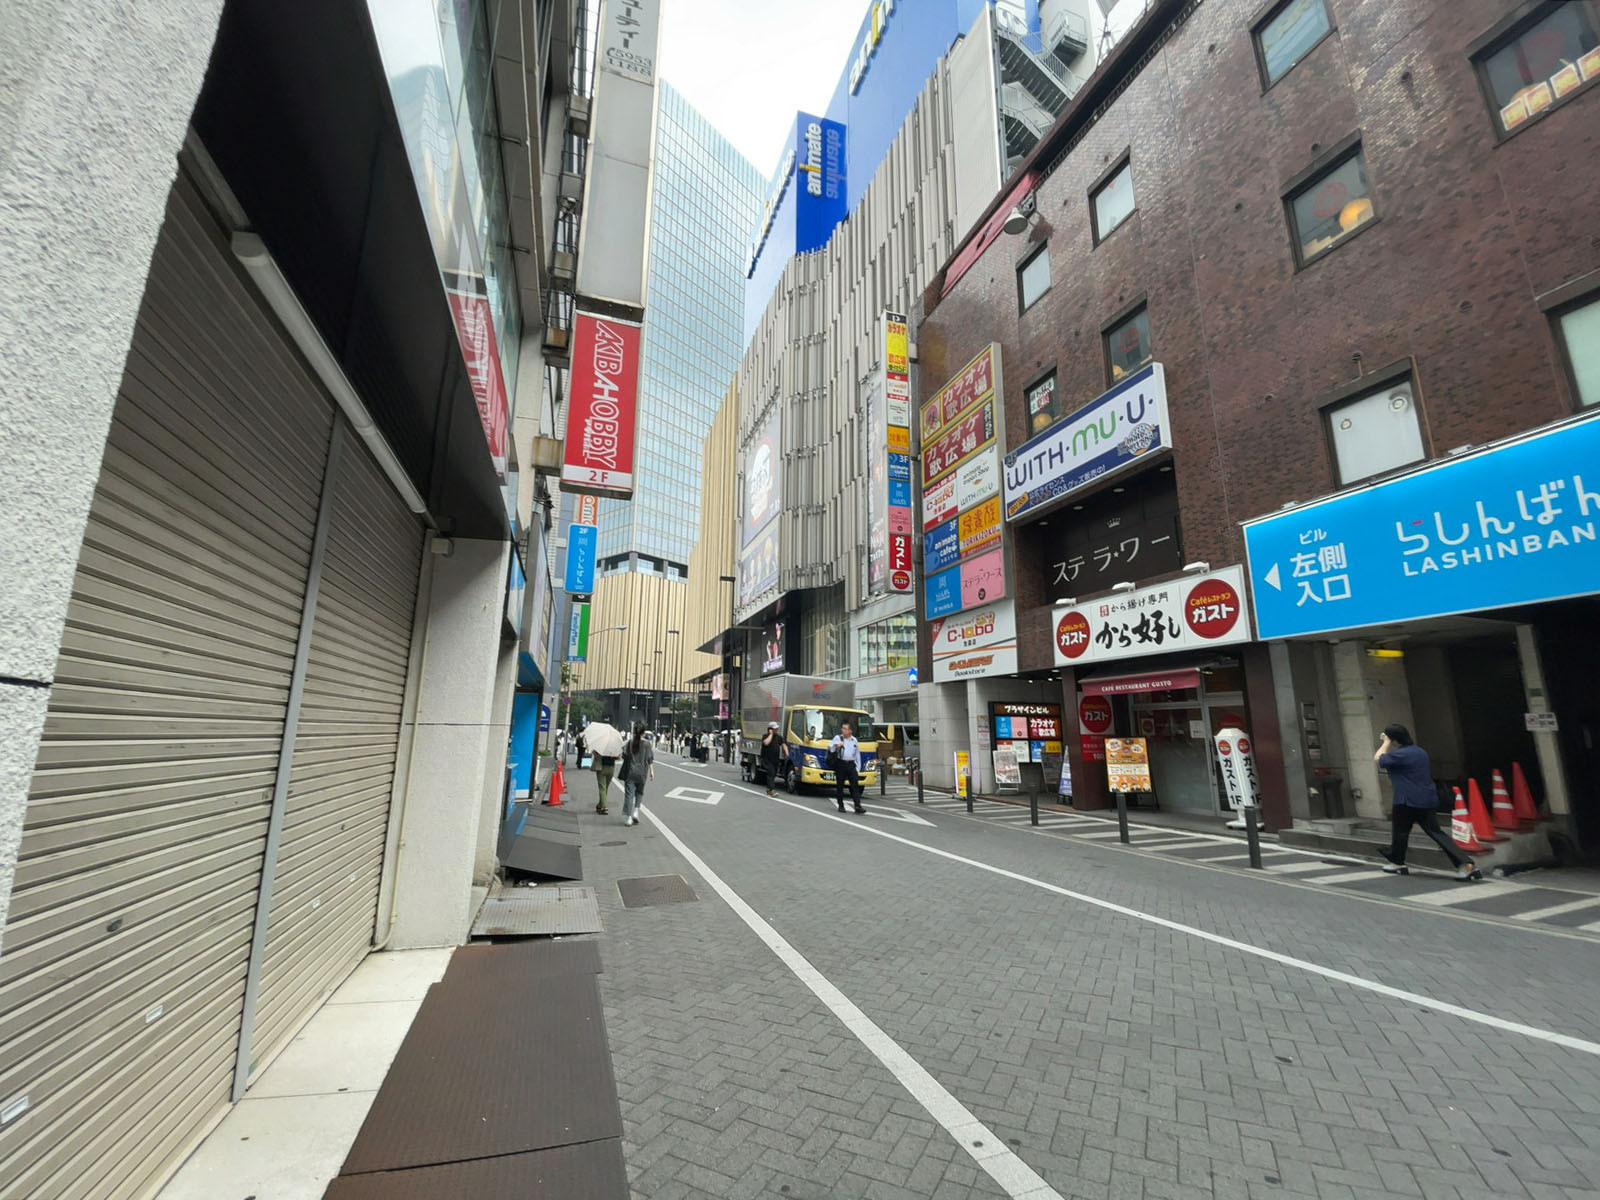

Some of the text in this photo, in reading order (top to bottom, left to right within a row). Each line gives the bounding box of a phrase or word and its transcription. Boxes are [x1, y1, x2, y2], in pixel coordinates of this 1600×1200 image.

[799, 122, 822, 197] animate
[943, 357, 989, 406] カラオケ
[945, 374, 988, 420] 歌広場
[926, 414, 980, 462] カラオケ
[929, 431, 977, 477] 歌広場
[588, 470, 609, 482] 2F
[949, 520, 957, 531] 3F
[1299, 528, 1327, 545] ビル
[895, 536, 905, 569] ガスト
[1290, 542, 1347, 578] 左側
[1402, 522, 1596, 577] LASHINBAN
[1296, 573, 1352, 606] 入口
[1095, 610, 1181, 649] から好し
[1193, 603, 1235, 624] ガスト
[1060, 631, 1087, 646] ガスト
[1116, 683, 1150, 691] RESTAURANT
[1030, 719, 1055, 728] カラオケ
[1223, 758, 1236, 791] ガスト
[1243, 756, 1256, 790] ガスト
[1230, 795, 1242, 805] 1F
